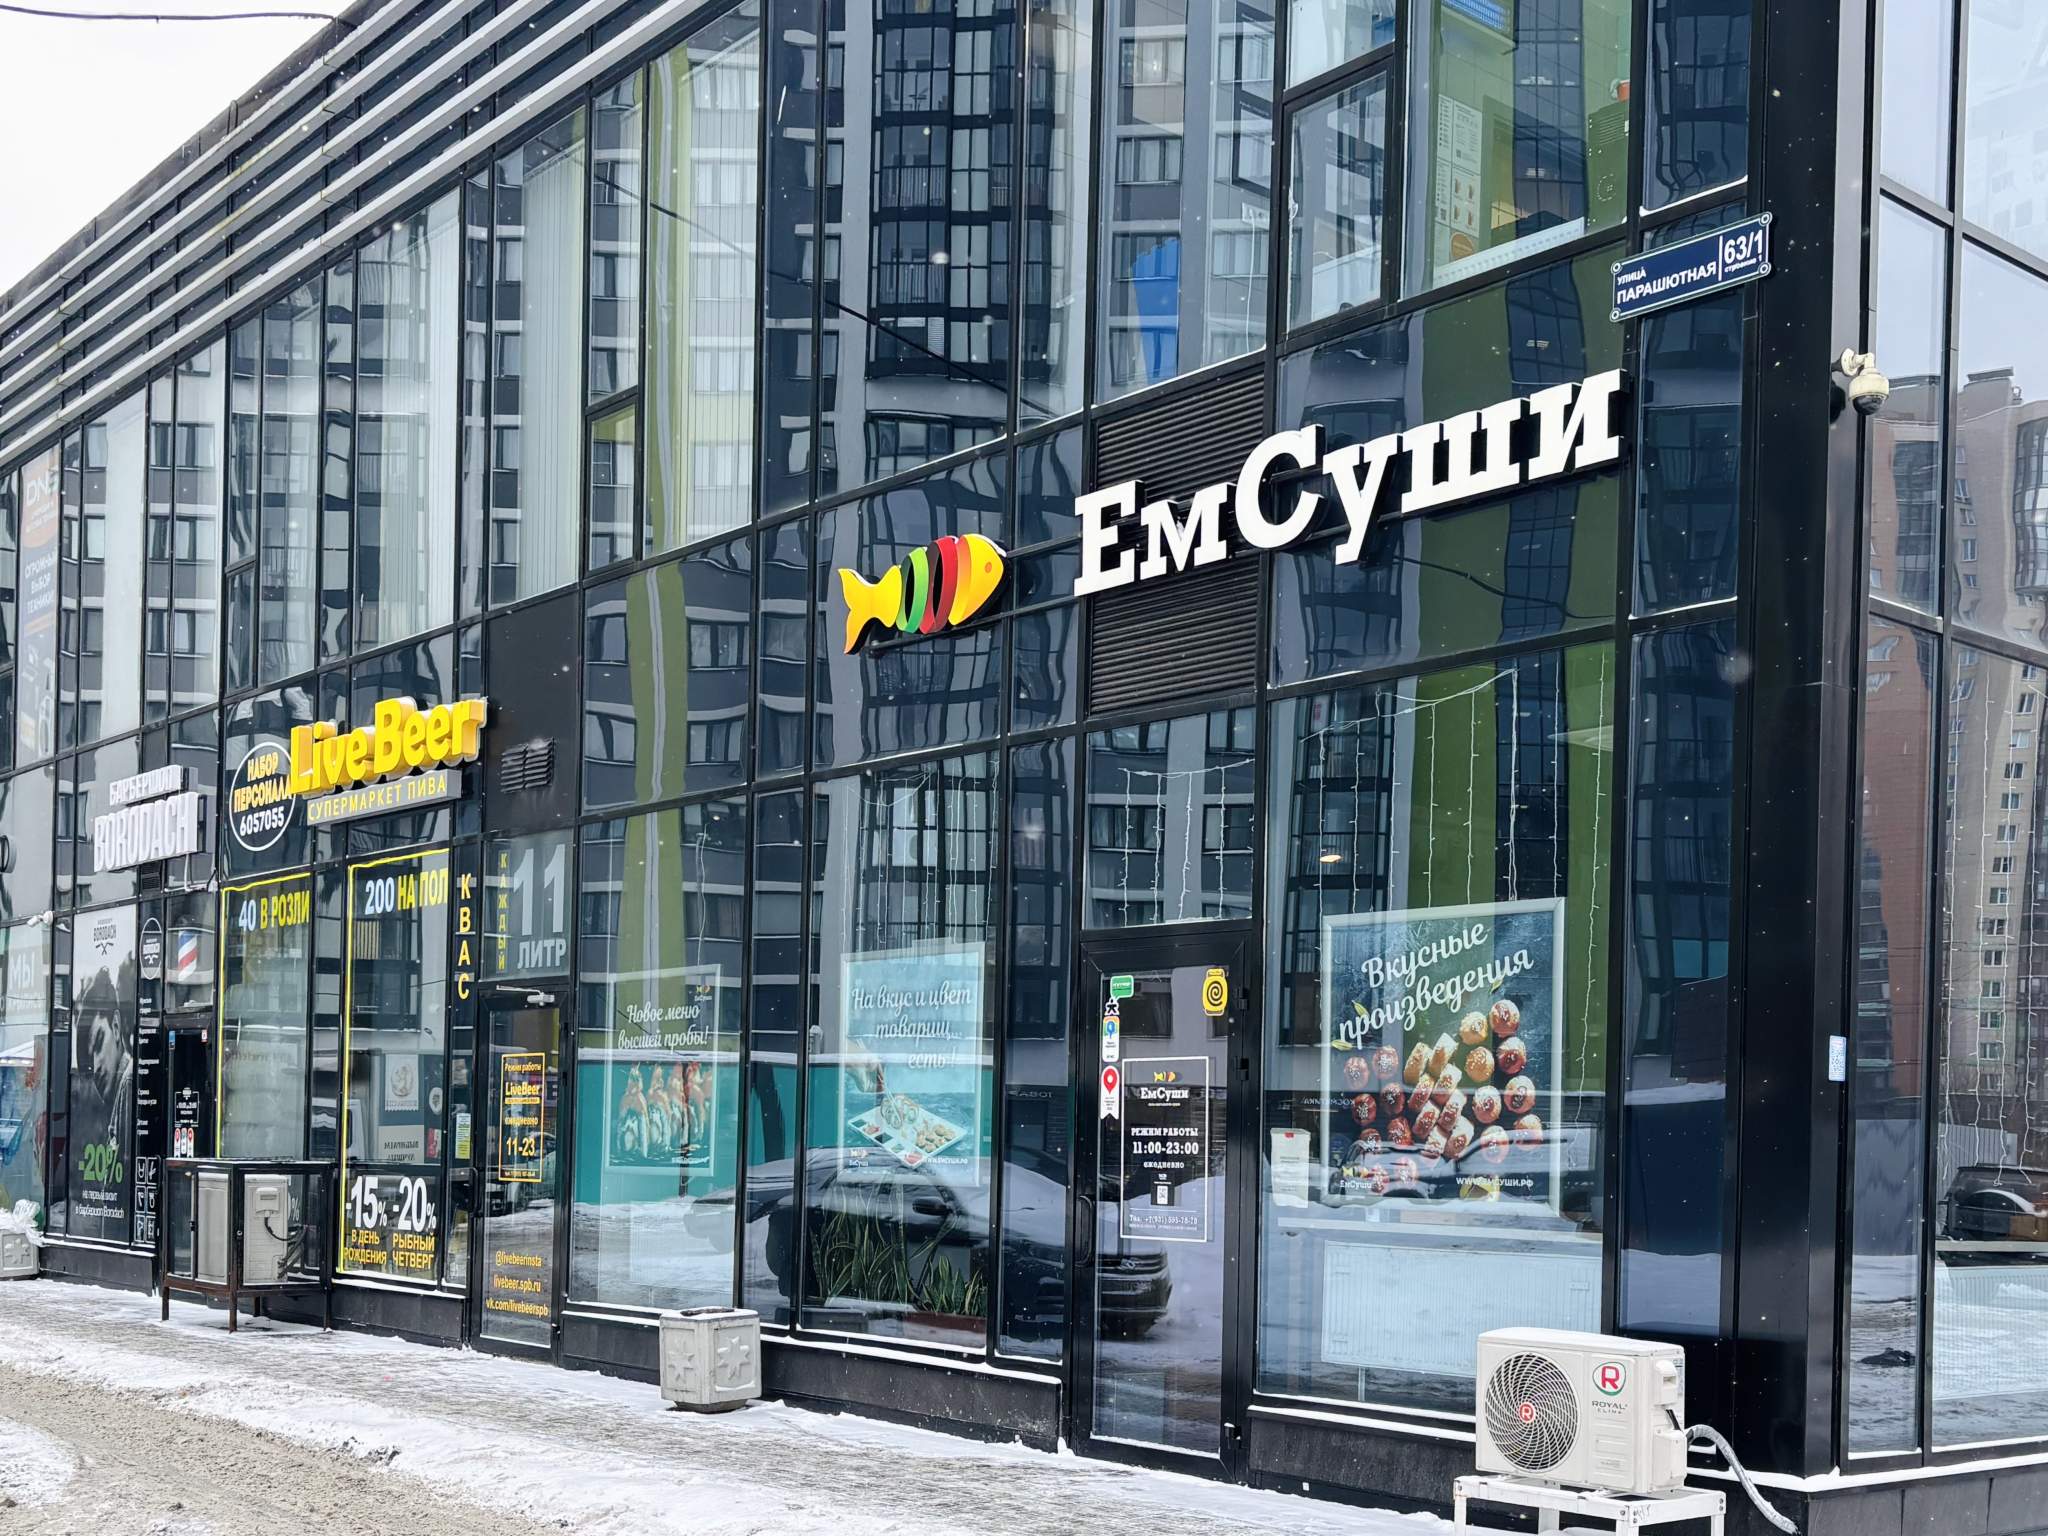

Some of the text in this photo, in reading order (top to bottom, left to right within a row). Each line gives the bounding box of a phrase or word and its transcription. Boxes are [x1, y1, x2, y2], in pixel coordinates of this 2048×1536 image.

[1724, 230, 1763, 264] 63/1
[1616, 261, 1717, 304] ПАРАШЮТНАЯ
[1617, 267, 1647, 286] УЛИЦА
[1073, 368, 1624, 596] ЕмСуши
[247, 751, 279, 782] НАБОР
[110, 766, 181, 806] БАРБЕРШОП
[233, 773, 292, 813] ПЕРСОНАЛА
[308, 774, 446, 820] СУПЕРМАРКЕТ ПИВА
[94, 793, 198, 872] BORODACH
[240, 805, 285, 837] 6057055
[364, 876, 395, 916] 200
[397, 874, 416, 911] НА
[513, 843, 566, 936] 11
[238, 899, 257, 931] 40
[260, 898, 268, 929] В
[498, 852, 509, 971] КАЖДЫЙ
[457, 872, 472, 1000] КВАС
[517, 938, 567, 970] ЛИТР
[1360, 923, 1489, 988] Вкусные
[626, 1001, 700, 1023] Новое меню
[851, 980, 971, 1017] На вкус и цвет
[1339, 949, 1535, 1050] произведения
[617, 1024, 709, 1055] высшей пробы!
[1140, 1087, 1189, 1101] ЕмСуши
[506, 1137, 535, 1156] 11-23
[1131, 1127, 1199, 1137] РЕЖИМ РАБОТЫ
[1132, 1141, 1200, 1155] 11:00-23:00
[78, 1144, 123, 1183] -20%
[1143, 1161, 1185, 1169] ежедневно
[393, 1177, 437, 1232] -20%
[351, 1229, 380, 1247] В ДЕНЬ
[392, 1232, 435, 1251] РЫБНЫЙ
[343, 1247, 387, 1265] РОЖДЕНИЯ
[392, 1250, 435, 1269] ЧЕТВЕРГ
[493, 1273, 541, 1293] livebeer.spb.ru
[485, 1297, 549, 1319] vk.com/livebeerspb
[1591, 1400, 1626, 1410] ROYAL
